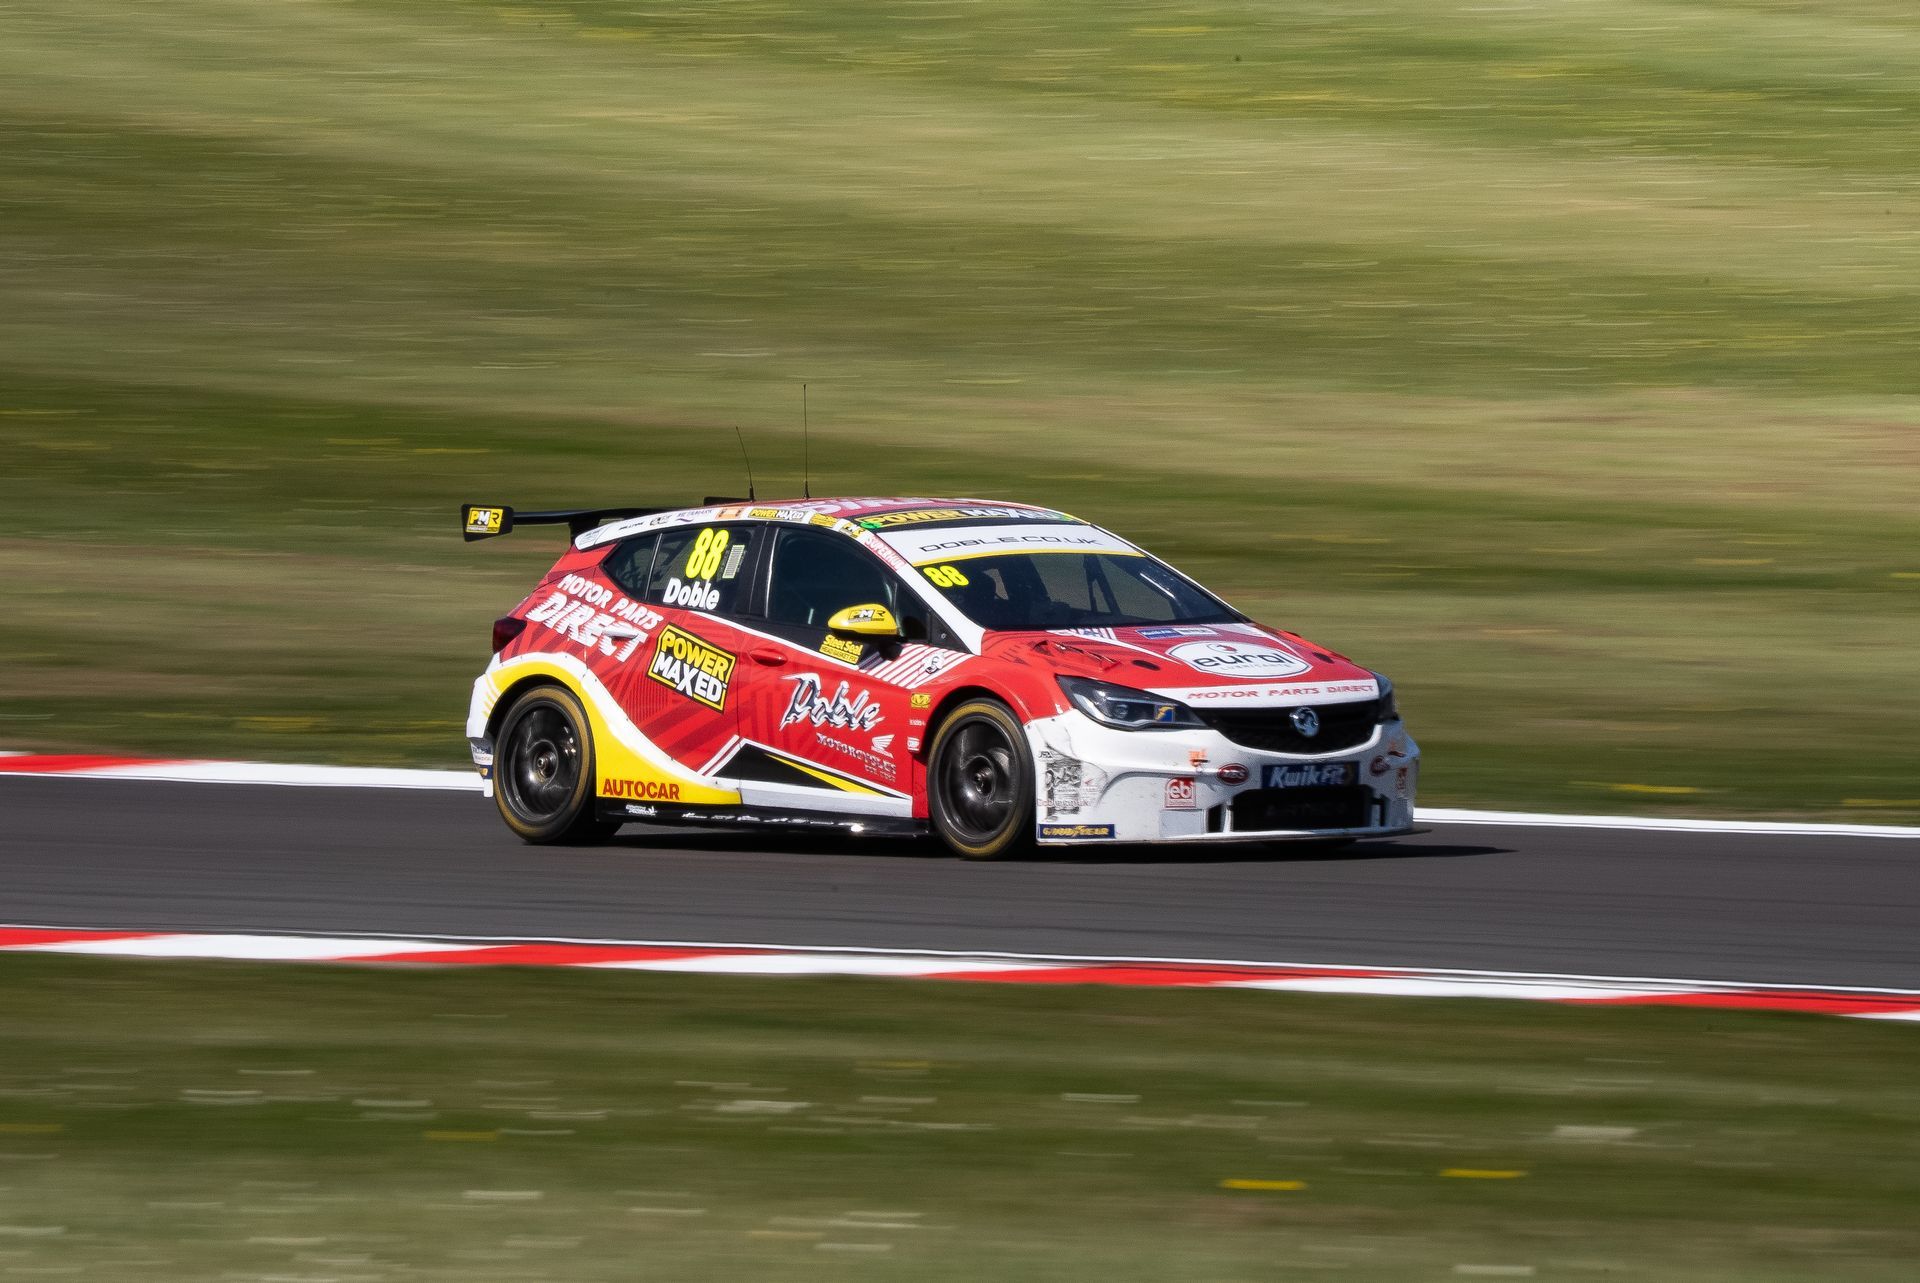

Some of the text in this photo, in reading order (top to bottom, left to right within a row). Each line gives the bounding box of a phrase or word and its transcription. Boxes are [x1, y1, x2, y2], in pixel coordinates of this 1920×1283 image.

[469, 510, 500, 525] PMR
[750, 509, 776, 518] POWER
[776, 509, 804, 520] MAXED
[871, 509, 965, 527] POWER
[685, 527, 730, 580] 88
[922, 565, 970, 588] 88
[556, 573, 664, 630] MOTOR PARTS
[662, 577, 721, 610] Doble
[524, 591, 649, 663] DIRECT
[661, 630, 729, 682] POWER
[823, 634, 863, 654] Steel Seal
[652, 651, 723, 702] MAXED
[779, 672, 886, 732] Doble
[1187, 685, 1374, 700] MOTOR PARTS DIRECT
[816, 732, 897, 775] MOTORCYCLES
[602, 778, 680, 801] AUTOCAR
[1269, 765, 1320, 789] Kwik
